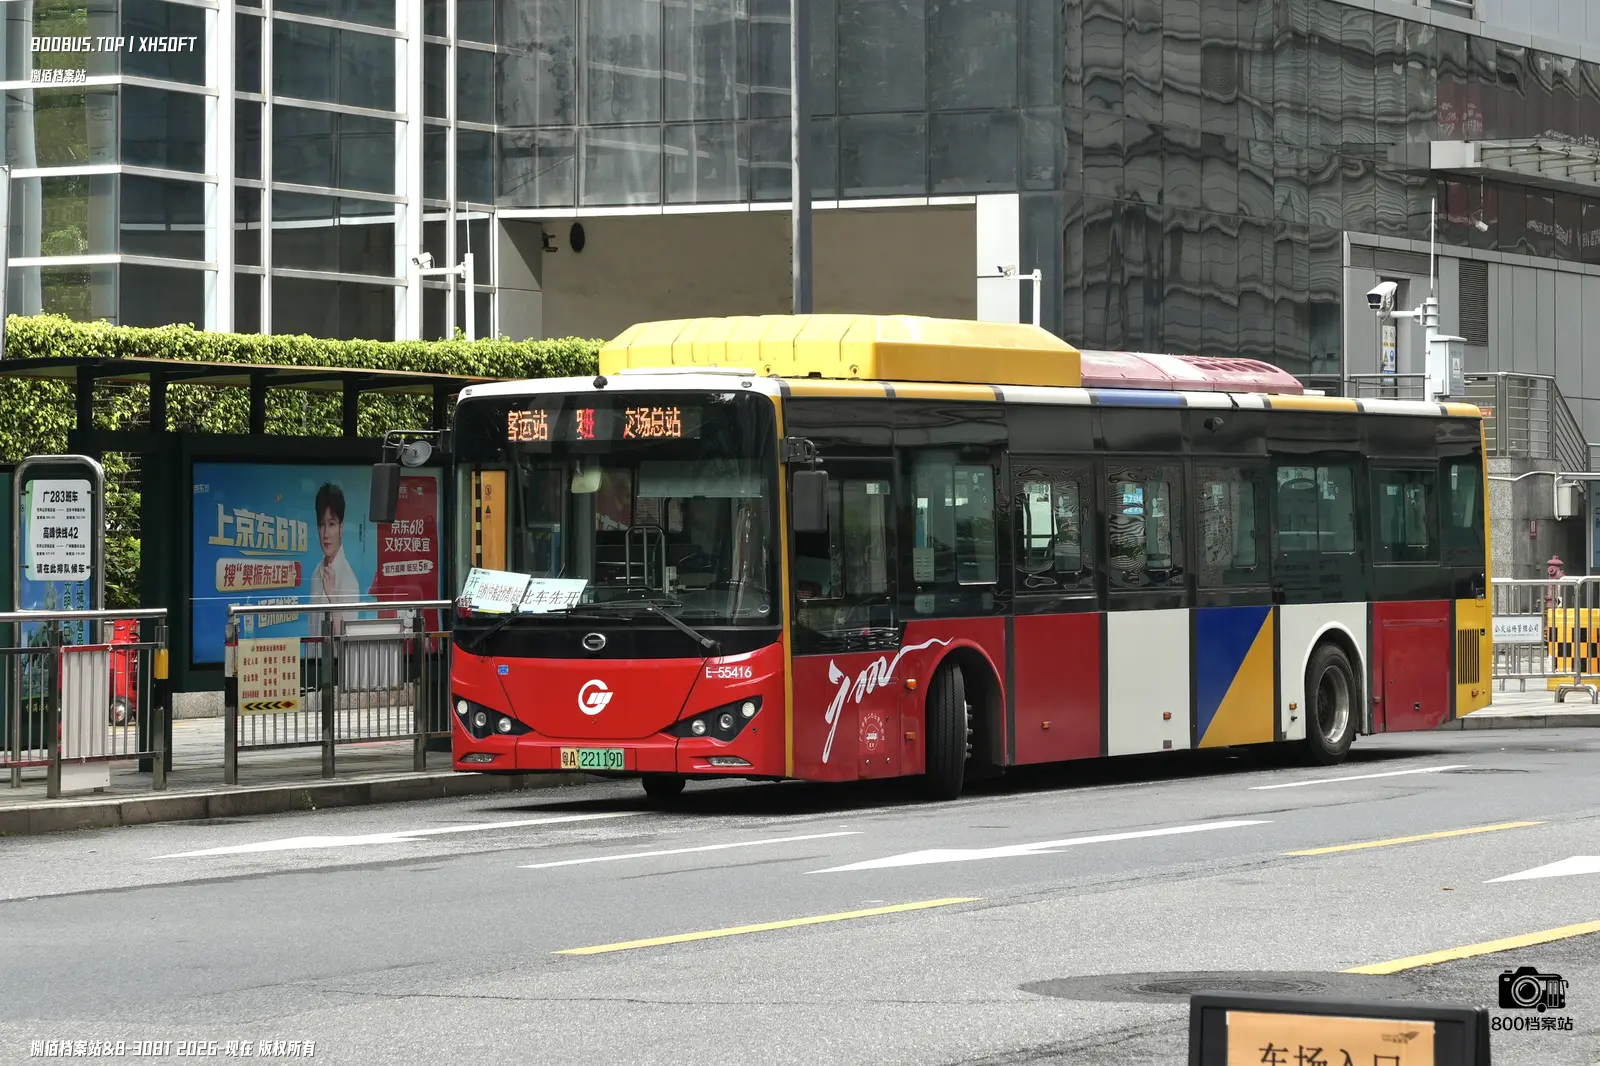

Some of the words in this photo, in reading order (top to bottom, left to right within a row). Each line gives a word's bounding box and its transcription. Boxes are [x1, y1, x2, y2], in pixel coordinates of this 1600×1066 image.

[43, 490, 78, 503] 广283班车
[43, 527, 79, 539] 高峰快线42
[208, 503, 308, 552] 上京东618
[391, 519, 424, 534] 京东618
[385, 537, 430, 552] 又好又便宜
[36, 563, 85, 574] 请在此排队候车
[705, 666, 752, 679] E-55416
